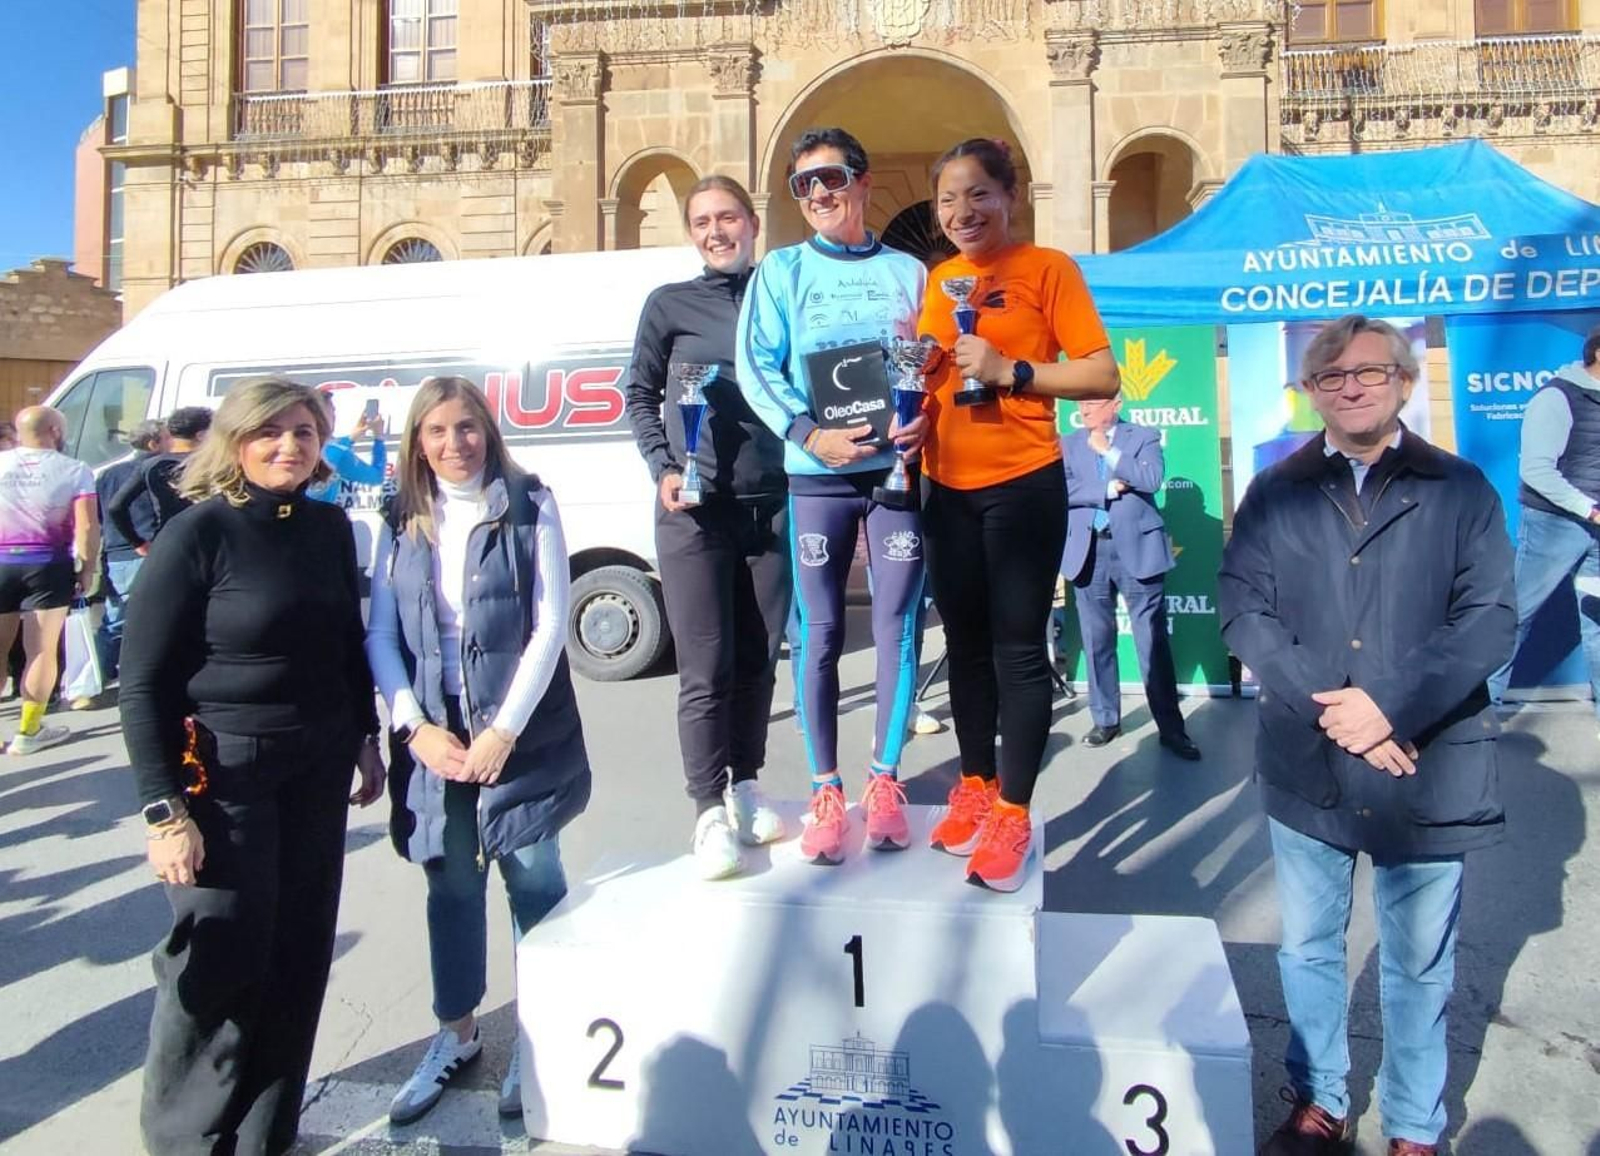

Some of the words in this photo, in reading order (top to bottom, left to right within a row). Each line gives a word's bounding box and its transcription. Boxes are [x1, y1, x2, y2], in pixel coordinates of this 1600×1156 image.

[1243, 241, 1473, 273] AYUNTAMIENTO
[1501, 240, 1538, 260] de
[1221, 270, 1452, 312] CONCEJALÍA
[1464, 273, 1516, 301] DE
[1467, 371, 1558, 393] SICNO
[824, 399, 886, 420] OleoCasa
[1129, 407, 1209, 426] RURAL
[1164, 595, 1215, 614] RAL
[844, 935, 865, 1008] 1
[585, 1017, 625, 1091] 2
[774, 1106, 954, 1141] AYUNTAMIENTO
[1123, 1084, 1169, 1156] 3
[774, 1129, 799, 1147] de
